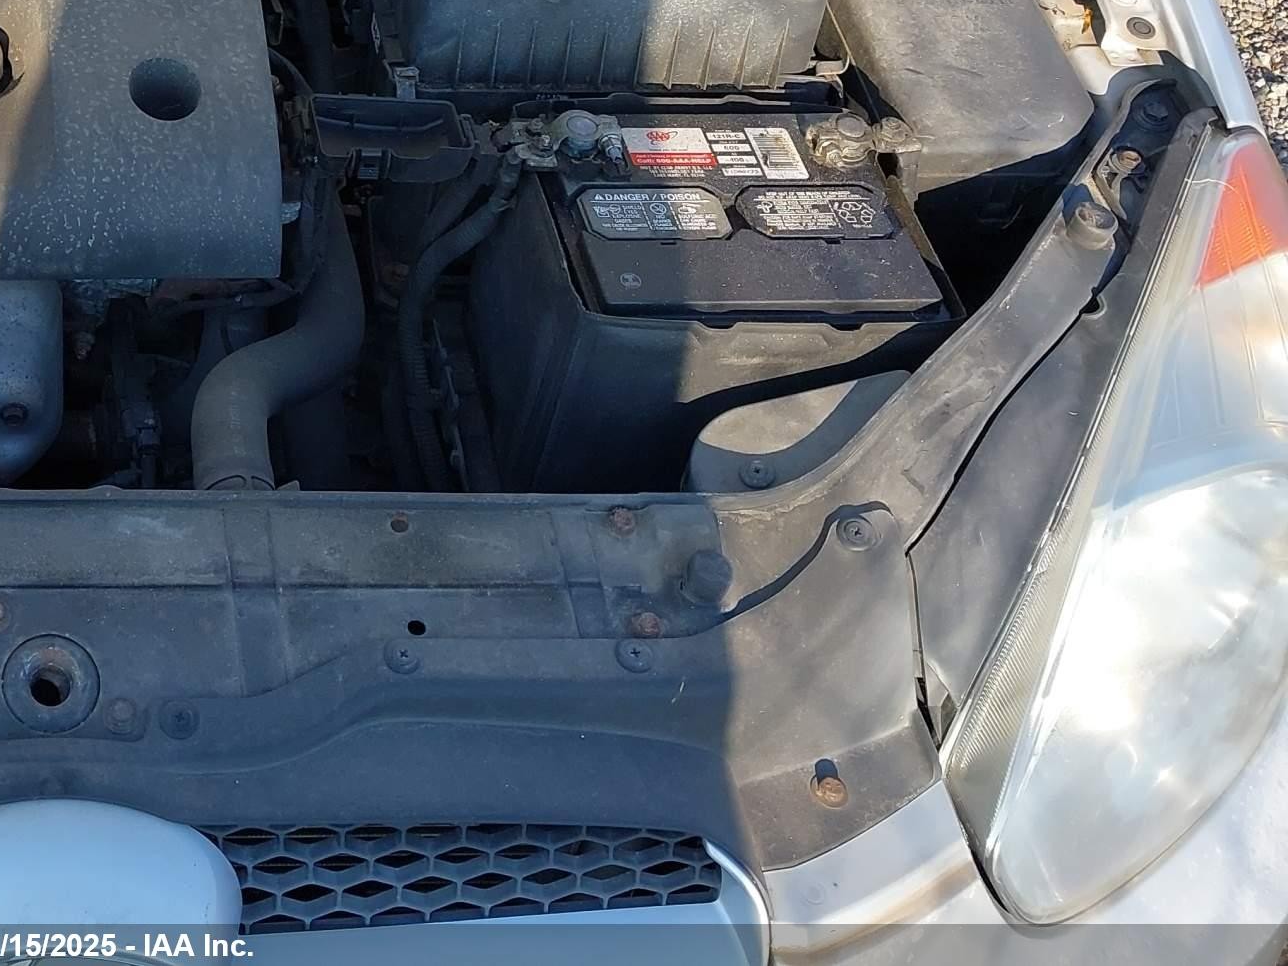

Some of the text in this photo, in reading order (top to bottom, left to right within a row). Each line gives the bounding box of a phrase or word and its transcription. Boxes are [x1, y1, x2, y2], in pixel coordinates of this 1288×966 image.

[646, 130, 671, 142] AAA
[604, 193, 650, 201] DANGER
[660, 193, 701, 201] POISON
